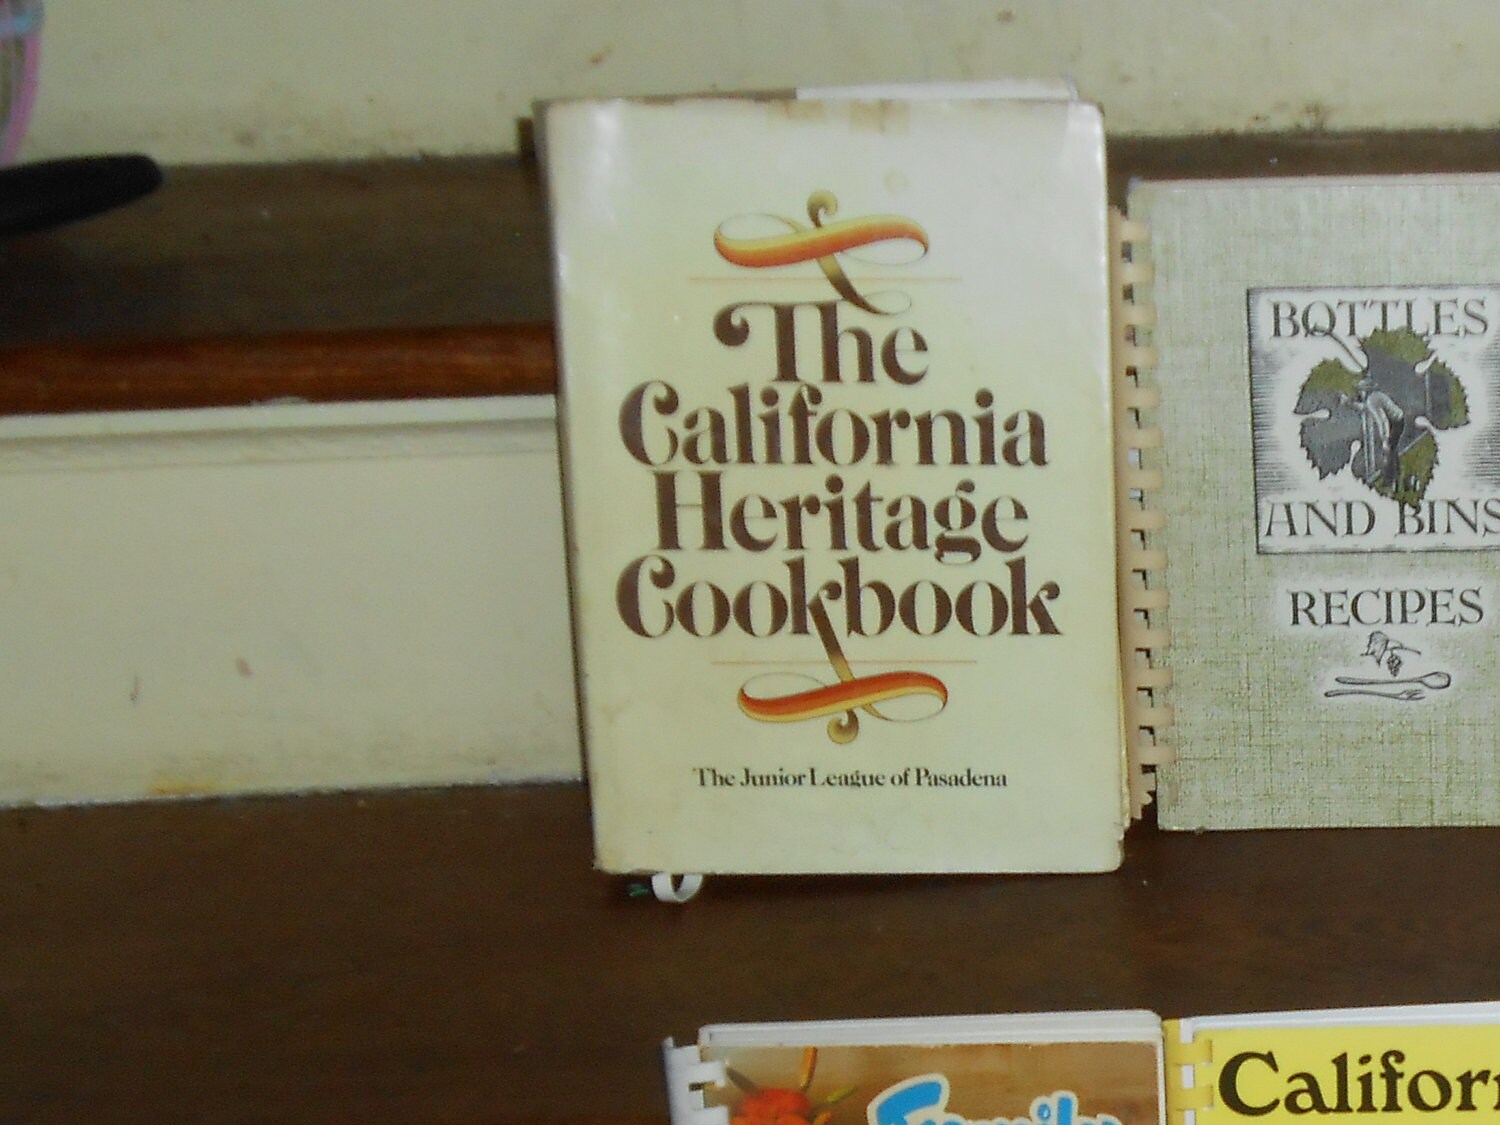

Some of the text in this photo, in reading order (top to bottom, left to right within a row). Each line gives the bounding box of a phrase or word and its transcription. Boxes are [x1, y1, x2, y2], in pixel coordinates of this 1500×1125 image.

[713, 299, 929, 385] The
[1268, 296, 1490, 339] BOTTLES
[618, 380, 1050, 468] California
[652, 470, 1031, 566] Heritage
[1264, 499, 1376, 538] AND
[615, 554, 1063, 641] Cookbook
[1289, 587, 1484, 626] RECIPES
[693, 767, 1008, 788] The Junior League of Pasadena
